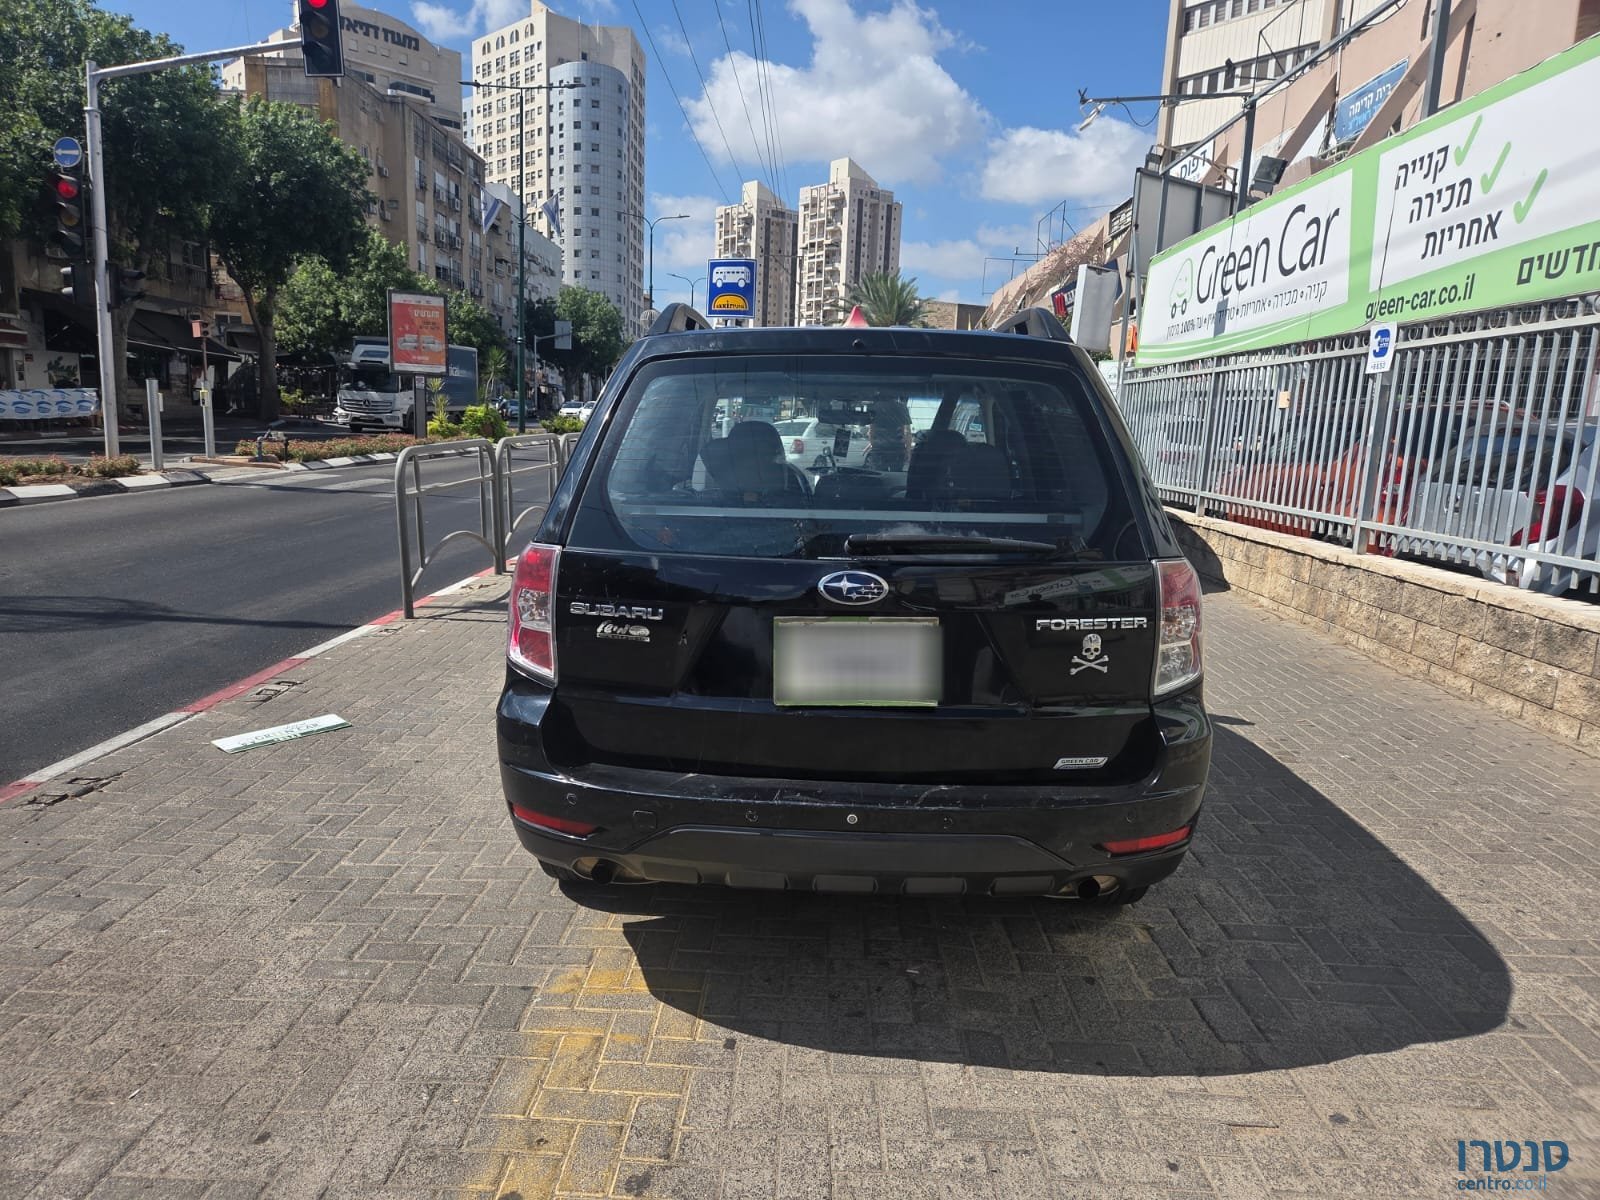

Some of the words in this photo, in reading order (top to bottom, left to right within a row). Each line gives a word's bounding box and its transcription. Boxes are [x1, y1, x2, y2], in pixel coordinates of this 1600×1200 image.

[1394, 144, 1450, 191] קנייה
[1408, 177, 1473, 224] מכירה
[1420, 209, 1503, 260] אחריות
[1196, 237, 1271, 304] Green
[1278, 204, 1340, 277] Car
[1272, 288, 1298, 310] מכירה
[1304, 280, 1328, 303] קניה
[1239, 297, 1268, 318] אחריות
[569, 601, 664, 621] SUBARU
[1036, 616, 1148, 631] FORESTER
